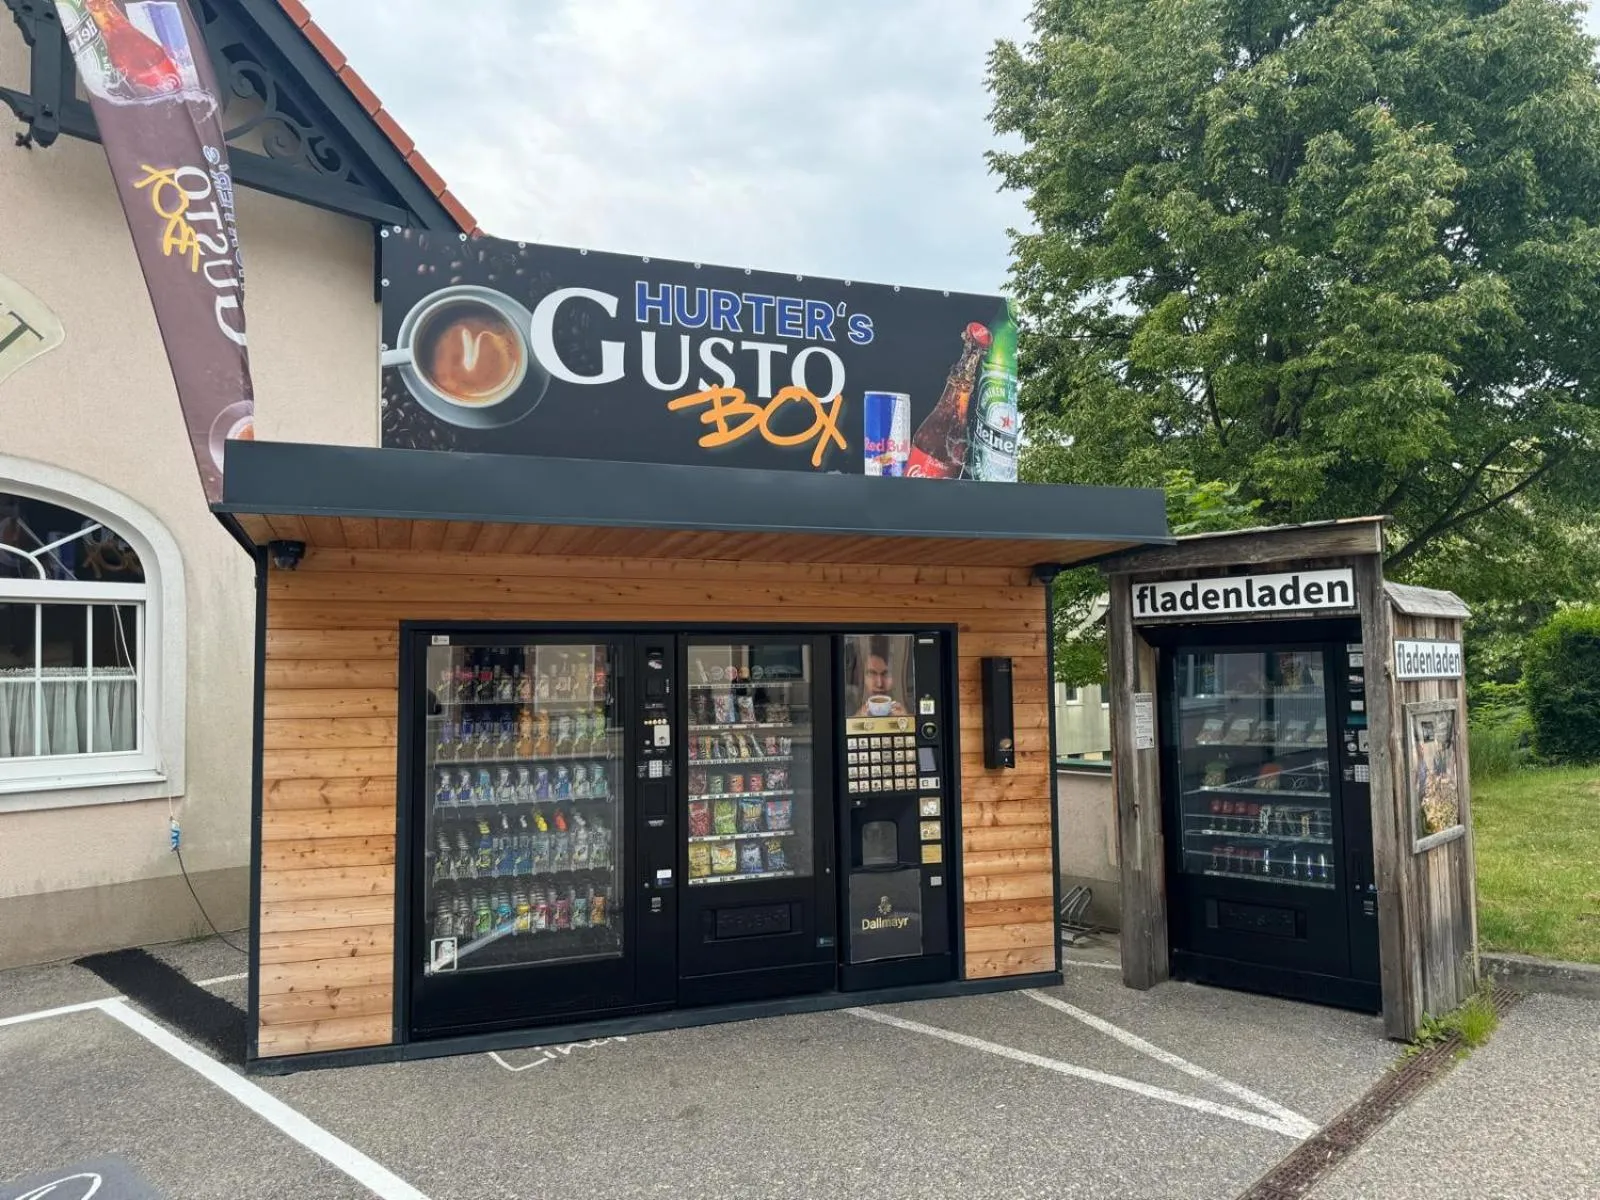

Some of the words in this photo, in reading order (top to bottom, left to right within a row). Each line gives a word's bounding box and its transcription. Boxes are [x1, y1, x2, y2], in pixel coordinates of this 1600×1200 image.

[635, 280, 874, 346] HURTER's
[530, 286, 846, 404] GUSTO
[667, 384, 848, 468] BOX
[1137, 576, 1349, 613] fladenladen
[1397, 643, 1460, 674] fladenladen
[862, 917, 908, 930] Dallmayr
